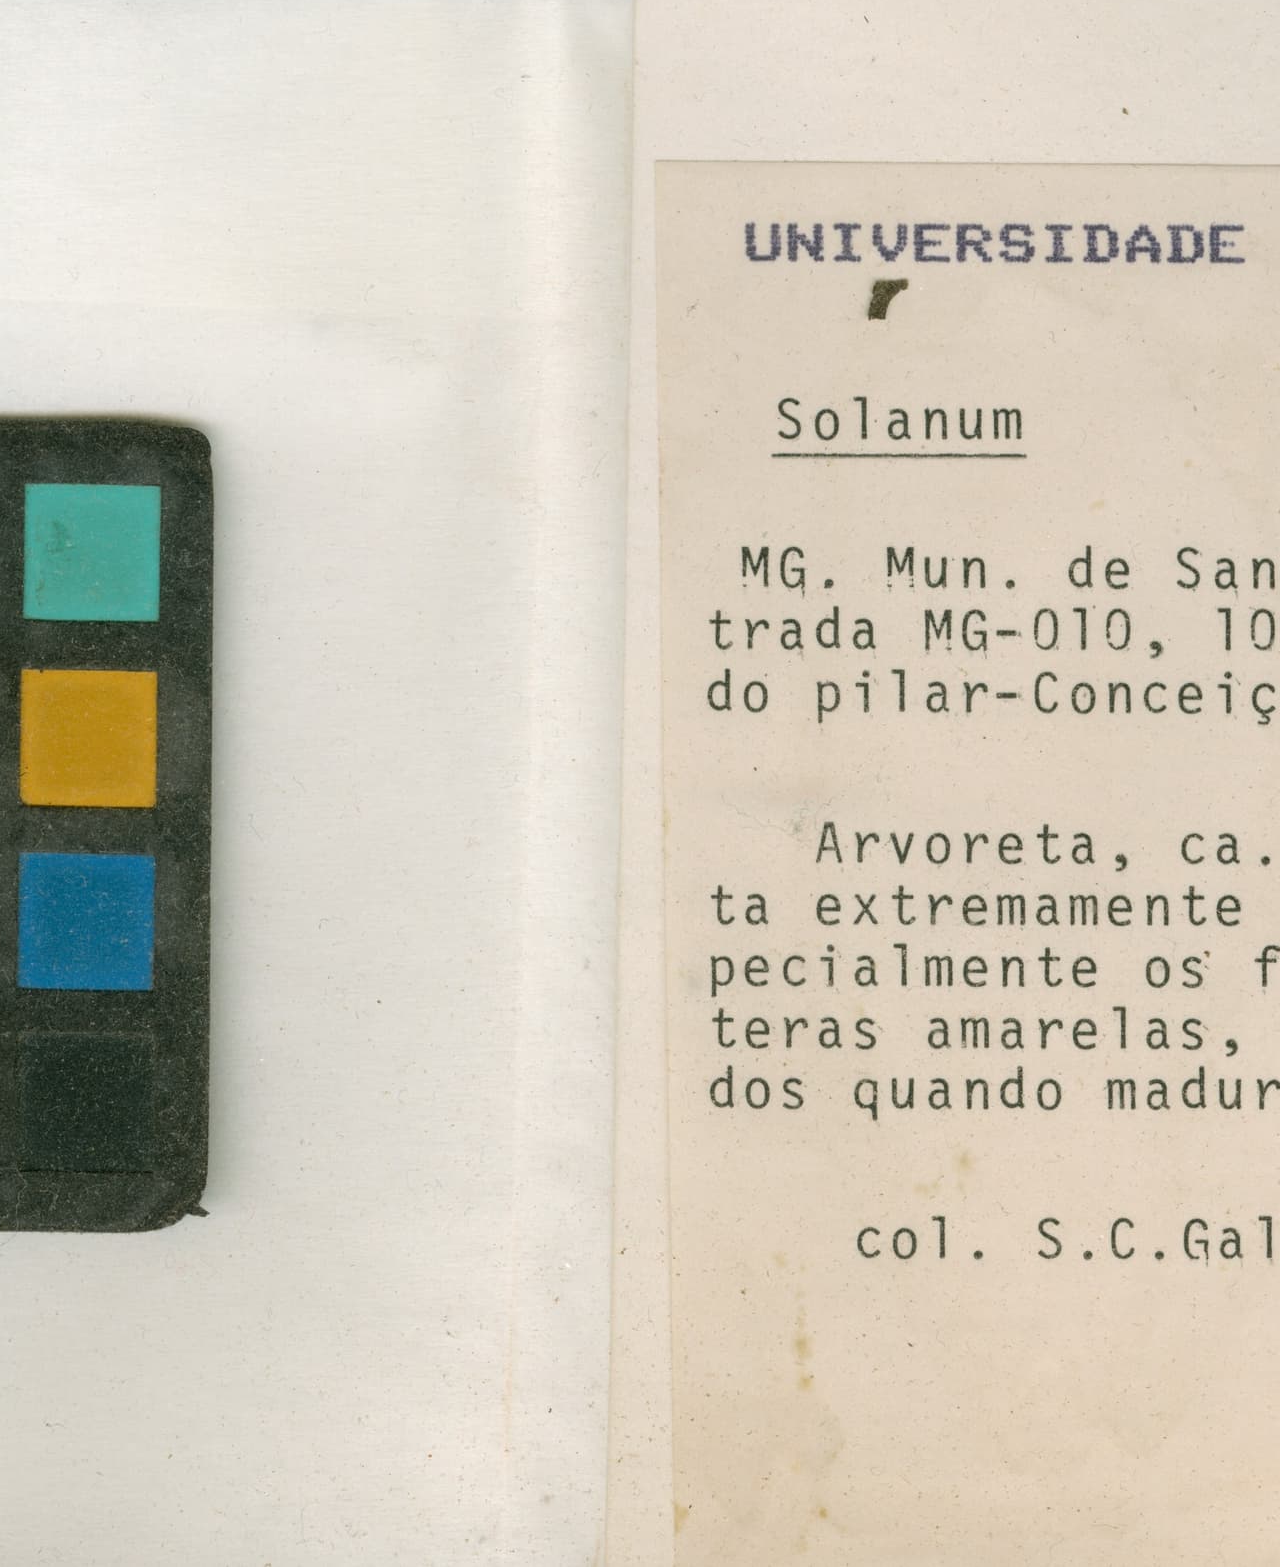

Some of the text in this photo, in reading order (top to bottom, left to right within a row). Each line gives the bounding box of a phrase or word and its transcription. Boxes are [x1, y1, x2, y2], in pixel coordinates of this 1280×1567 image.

[745, 223, 1245, 264] UNIVERSIDADE
[778, 396, 1022, 441] Solanum
[741, 546, 834, 597] MG.
[887, 547, 1015, 589] Mun.
[1068, 545, 1129, 590] de
[709, 606, 876, 650] trada
[707, 668, 768, 713] do
[816, 822, 1128, 872] Arvoreta,
[1181, 833, 1270, 866] ca.
[711, 885, 768, 925] ta
[816, 885, 1241, 927] extremamente
[710, 943, 1097, 998] pecialmente
[1146, 956, 1203, 988] os
[712, 1008, 876, 1050] teras
[928, 1006, 1238, 1057] amarelas,
[710, 1065, 804, 1110] dos
[854, 1066, 1062, 1121] quando
[857, 1216, 983, 1260] col.
